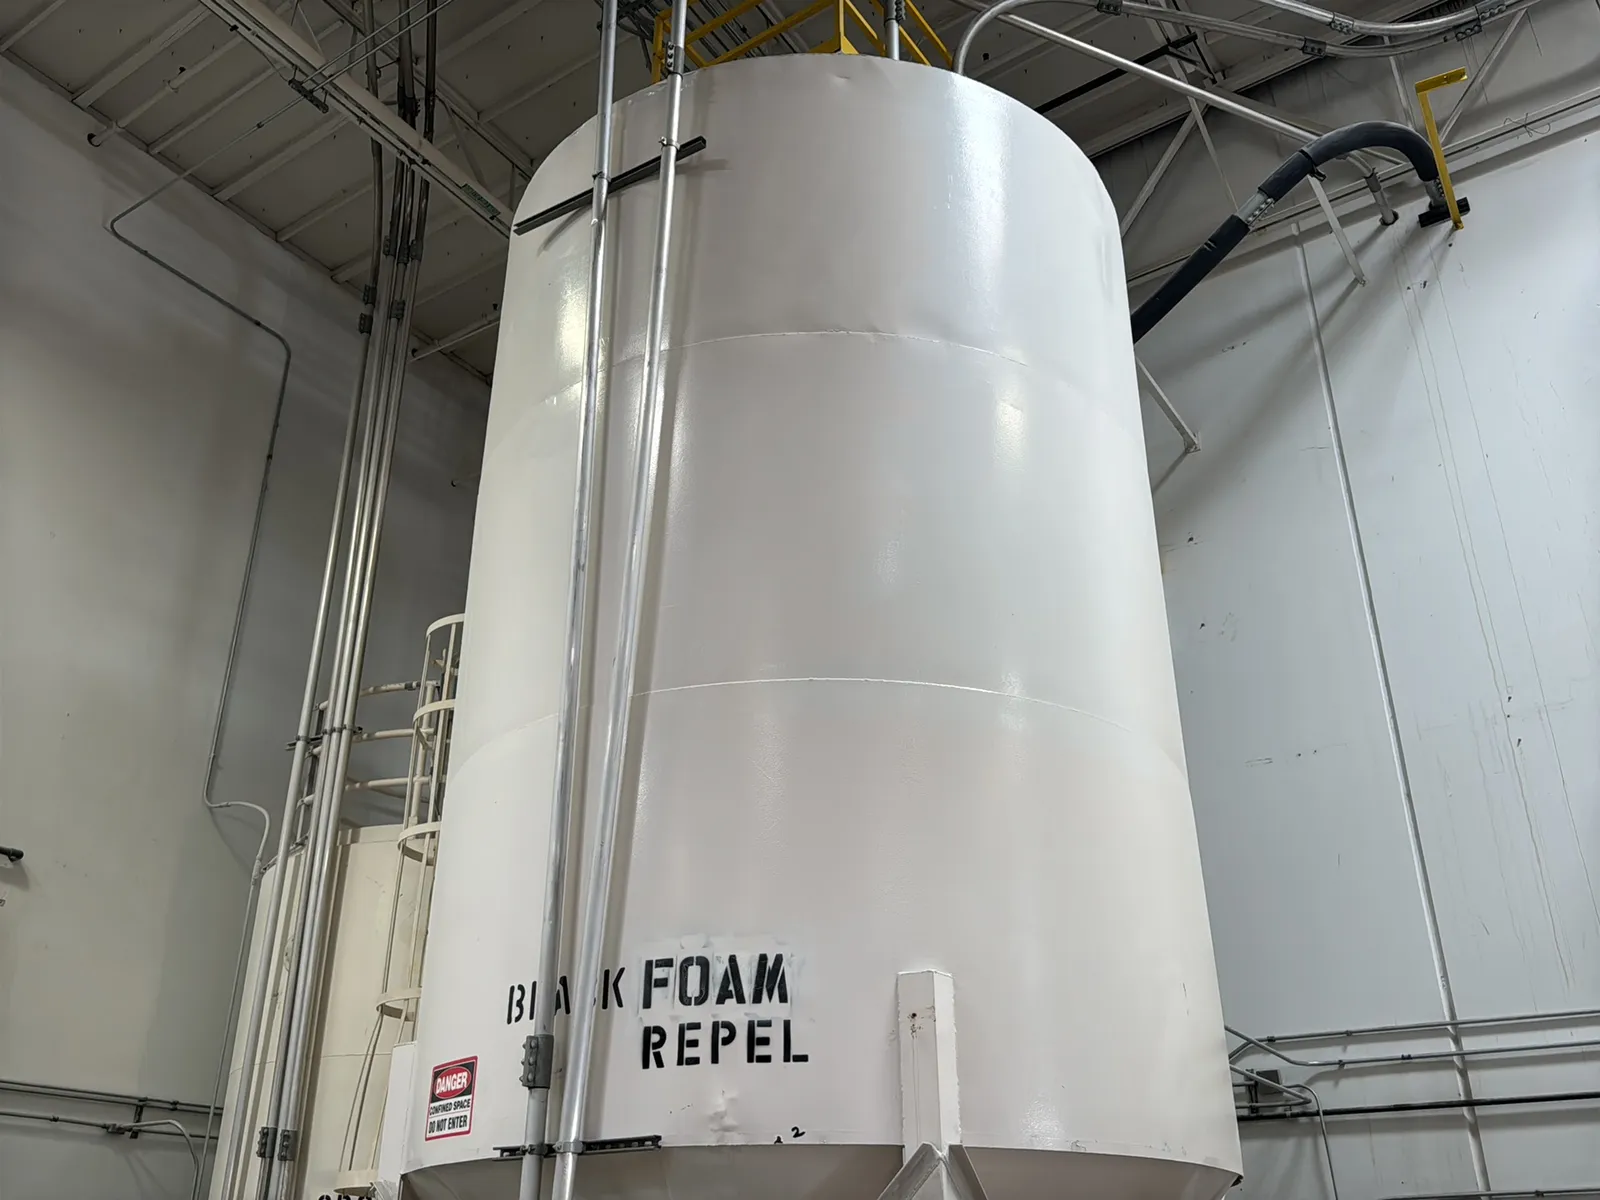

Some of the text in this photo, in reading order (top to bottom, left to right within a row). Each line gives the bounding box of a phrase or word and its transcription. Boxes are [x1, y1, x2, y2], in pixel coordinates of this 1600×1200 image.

[507, 953, 788, 1025] BLAK FOAM
[642, 1019, 809, 1069] REPEL
[436, 1071, 468, 1095] DANGER
[429, 1098, 471, 1116] CONFINED SPACE
[428, 1114, 468, 1134] DO NOT ENTER
